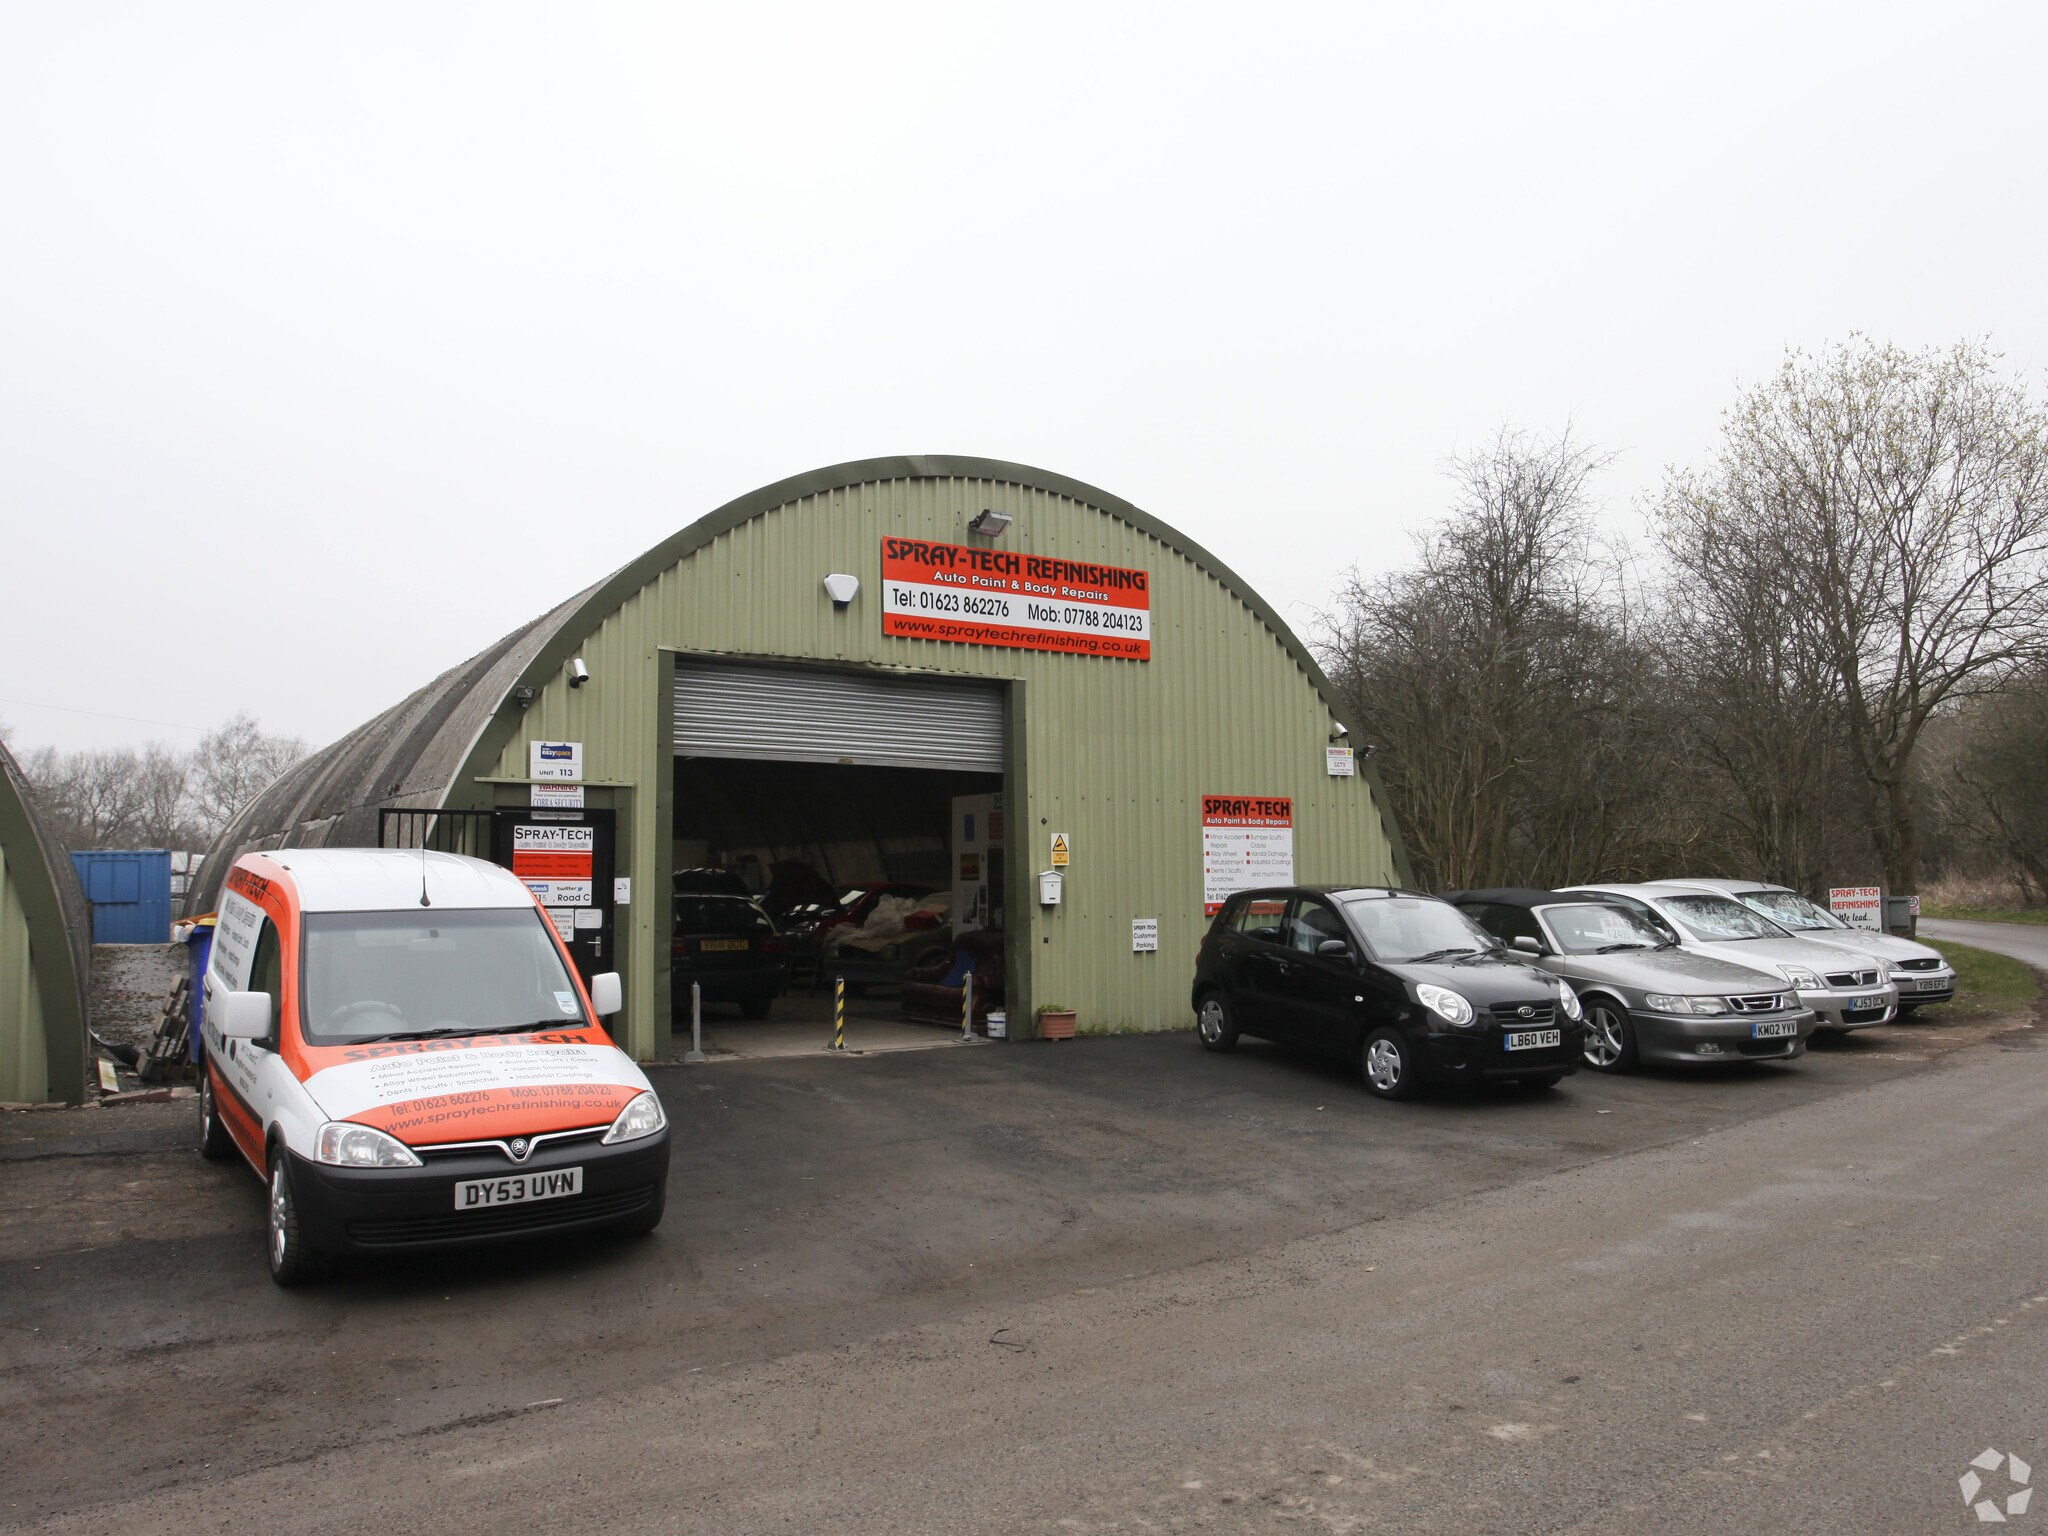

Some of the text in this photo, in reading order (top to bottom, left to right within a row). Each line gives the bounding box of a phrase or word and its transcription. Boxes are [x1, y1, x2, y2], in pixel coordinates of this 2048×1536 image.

[886, 539, 1145, 591] SPRAY-TECH REFINISHING
[933, 571, 1109, 601] Auto Paint & Body Repairs
[893, 588, 1143, 631] Tel: 01623 862276 Mob: 07788 204123
[894, 620, 1142, 654] www.spraytechrefinishing.co.uk
[560, 768, 573, 777] 113
[555, 798, 582, 808] SECURITY
[1204, 799, 1290, 817] SPRAY-TECH
[1206, 817, 1222, 825] Auto
[1248, 818, 1264, 826] Body
[1266, 818, 1290, 826] Repairs
[516, 828, 592, 840] SPRAY-TECH
[1831, 888, 1878, 898] SPRAY-TECH
[1832, 900, 1879, 910] REFINISHING
[1839, 913, 1850, 922] We
[1854, 998, 1871, 1009] KJ53
[1758, 1022, 1795, 1036] KM02 YVV
[344, 1035, 588, 1061] SPRAY-TECH
[1511, 1031, 1558, 1047] LB60 VEH
[370, 1049, 587, 1072] Auto Paint & Body Repairs
[378, 1062, 481, 1080] Minor Accident Repairs
[382, 1068, 492, 1088] Alloy Wheel Refurbishing
[386, 1088, 412, 1097] Dents
[421, 1082, 448, 1090] Scuffs
[456, 1077, 500, 1086] Scratches
[390, 1085, 612, 1116] Tel: 01623 862276 Mob: 07788 204123
[385, 1099, 622, 1133] www.spraytechrefinishing.co.uk
[466, 1172, 574, 1206] DY53 UVN
